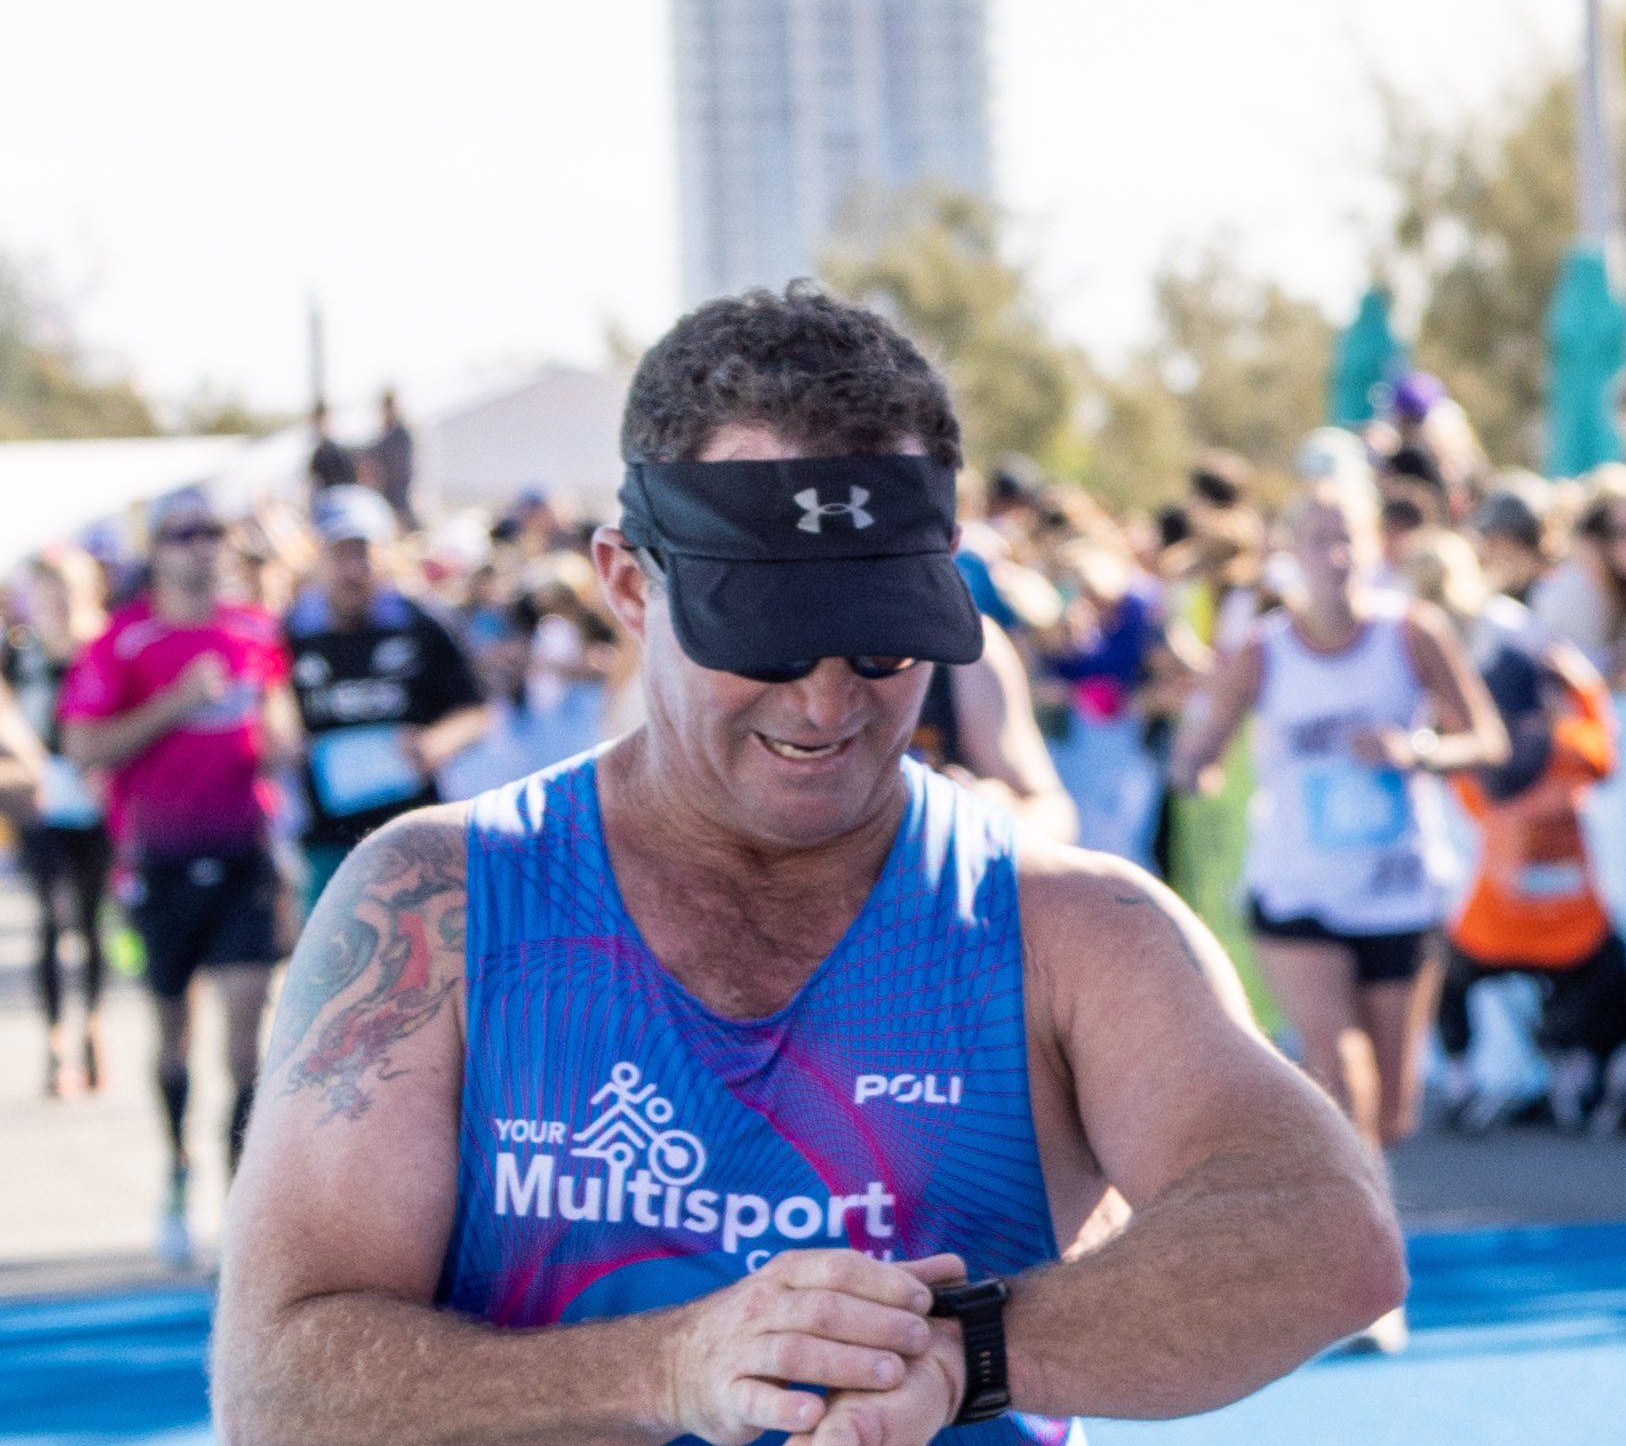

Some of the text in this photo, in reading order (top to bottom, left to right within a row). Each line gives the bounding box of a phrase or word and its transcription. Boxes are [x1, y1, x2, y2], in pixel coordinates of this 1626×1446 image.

[855, 1073, 962, 1104] POLI
[495, 1118, 565, 1145] YOUR
[495, 1152, 896, 1253] Multisport
